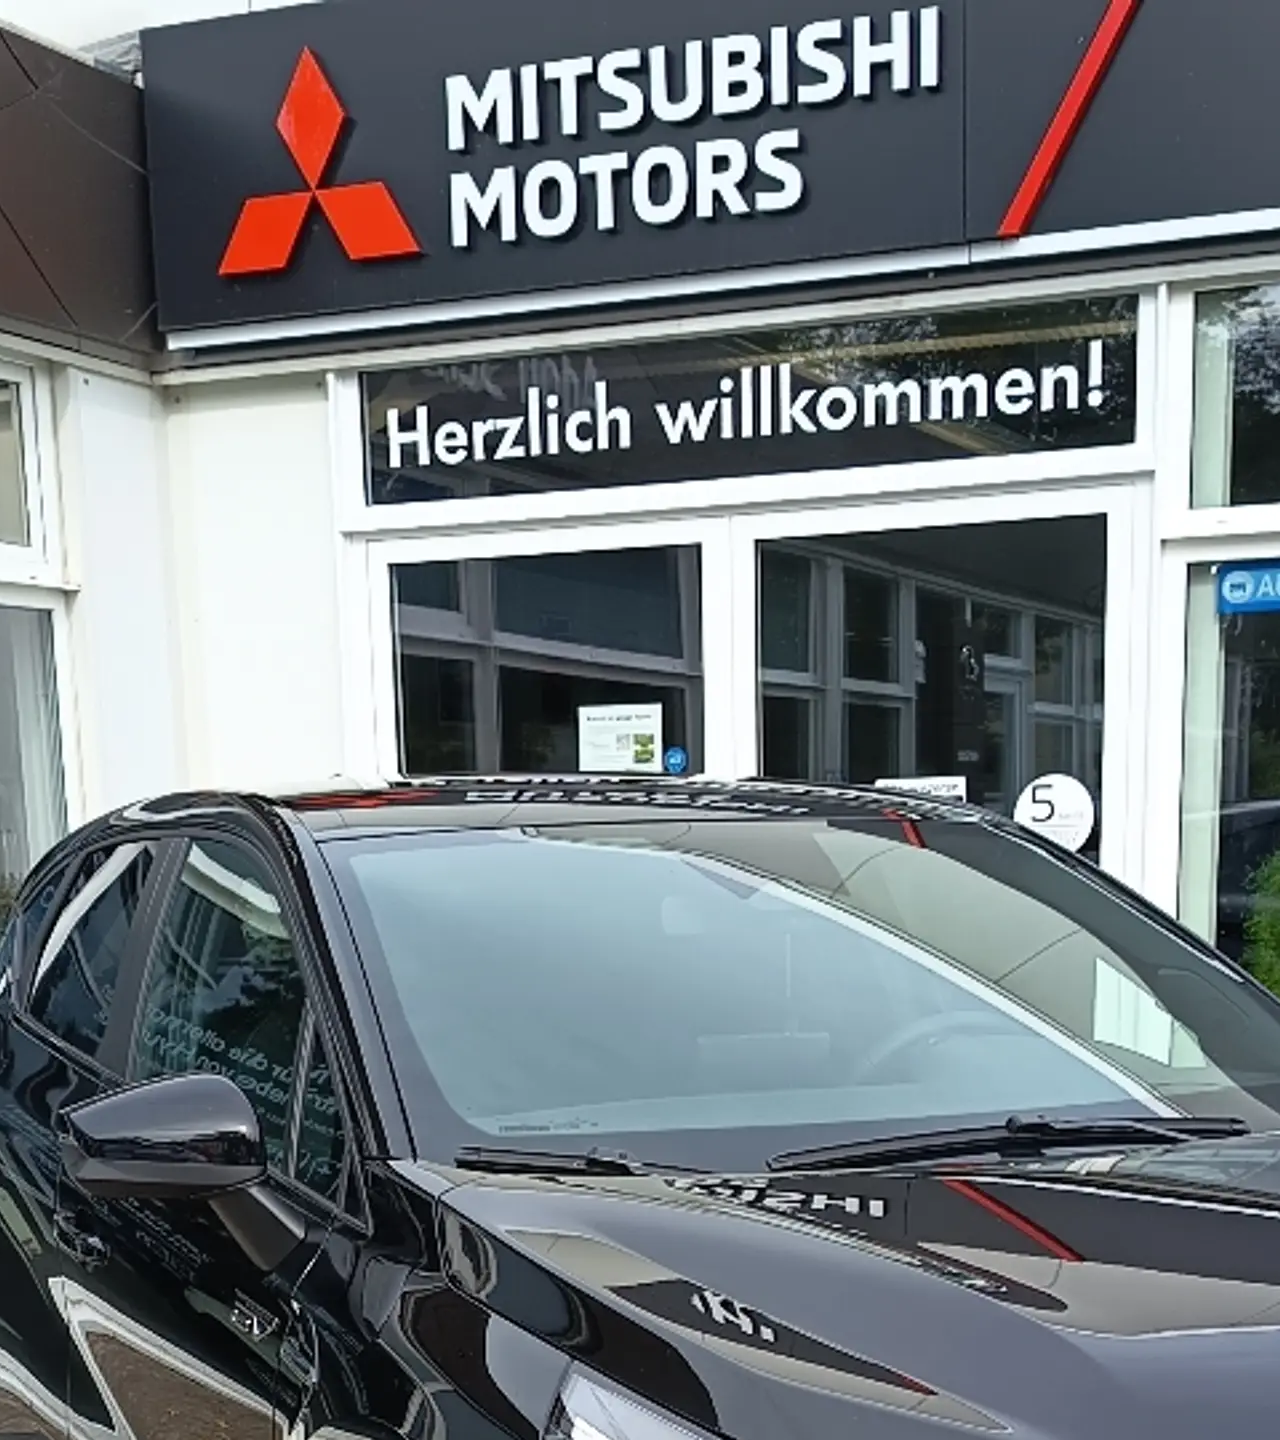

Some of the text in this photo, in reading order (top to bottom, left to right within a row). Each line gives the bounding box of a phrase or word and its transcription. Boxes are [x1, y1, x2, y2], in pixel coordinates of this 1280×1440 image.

[444, 6, 942, 152] MITSUBISHI
[448, 128, 806, 249] MOTORS
[385, 380, 632, 469] Herzlich
[655, 338, 1105, 446] willkommen!
[1031, 783, 1055, 823] 5
